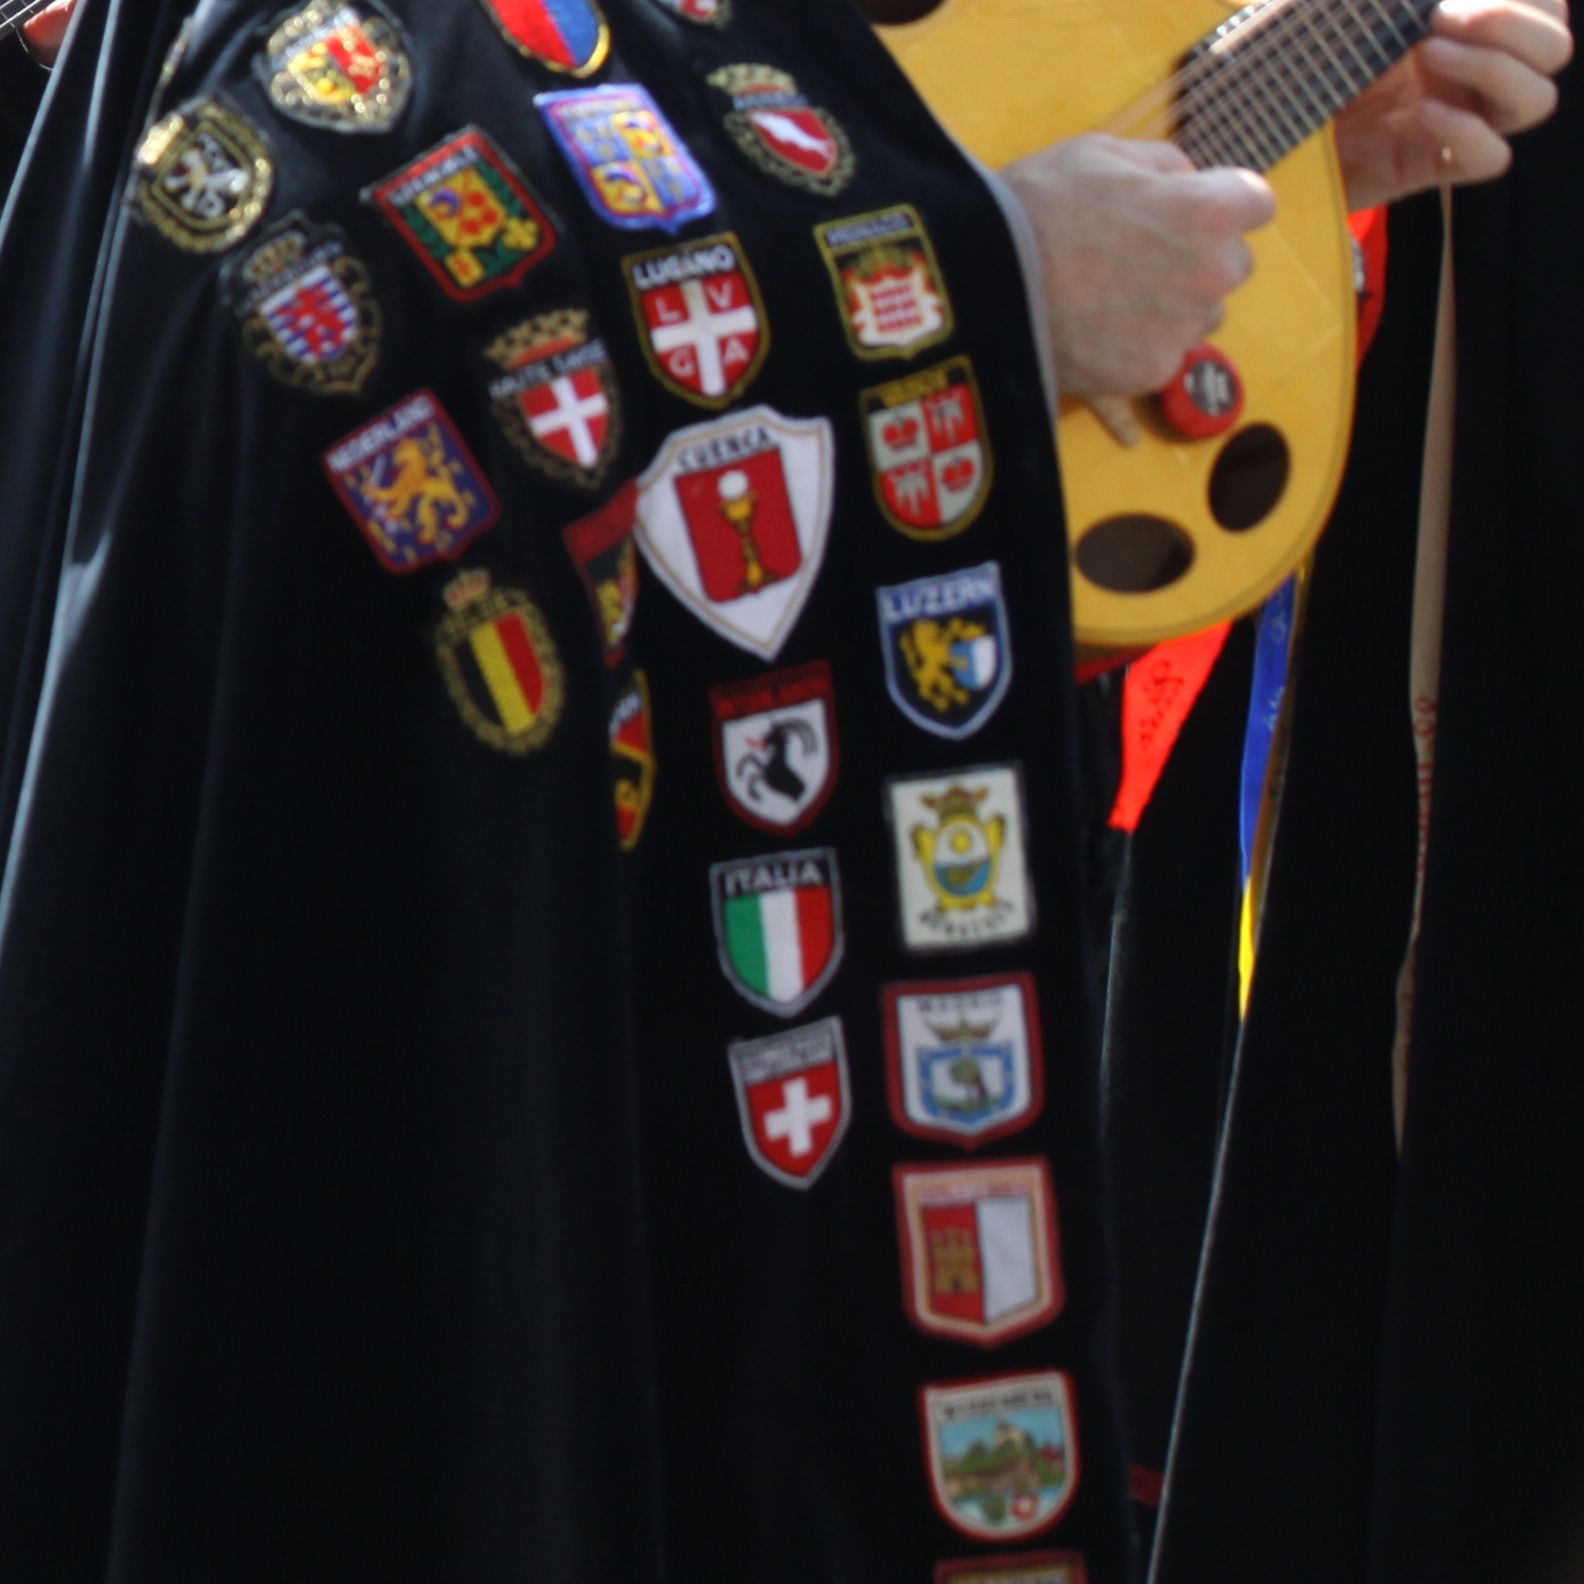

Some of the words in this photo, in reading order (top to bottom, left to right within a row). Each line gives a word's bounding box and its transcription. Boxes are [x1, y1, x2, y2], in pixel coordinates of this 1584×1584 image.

[633, 244, 735, 290] LUGANO
[655, 297, 681, 322] L
[706, 280, 733, 309] V
[669, 347, 694, 377] G
[723, 336, 749, 364] A
[677, 425, 772, 473] CUENCA
[883, 577, 998, 623] LUZERN
[724, 861, 822, 896] ITALIA
